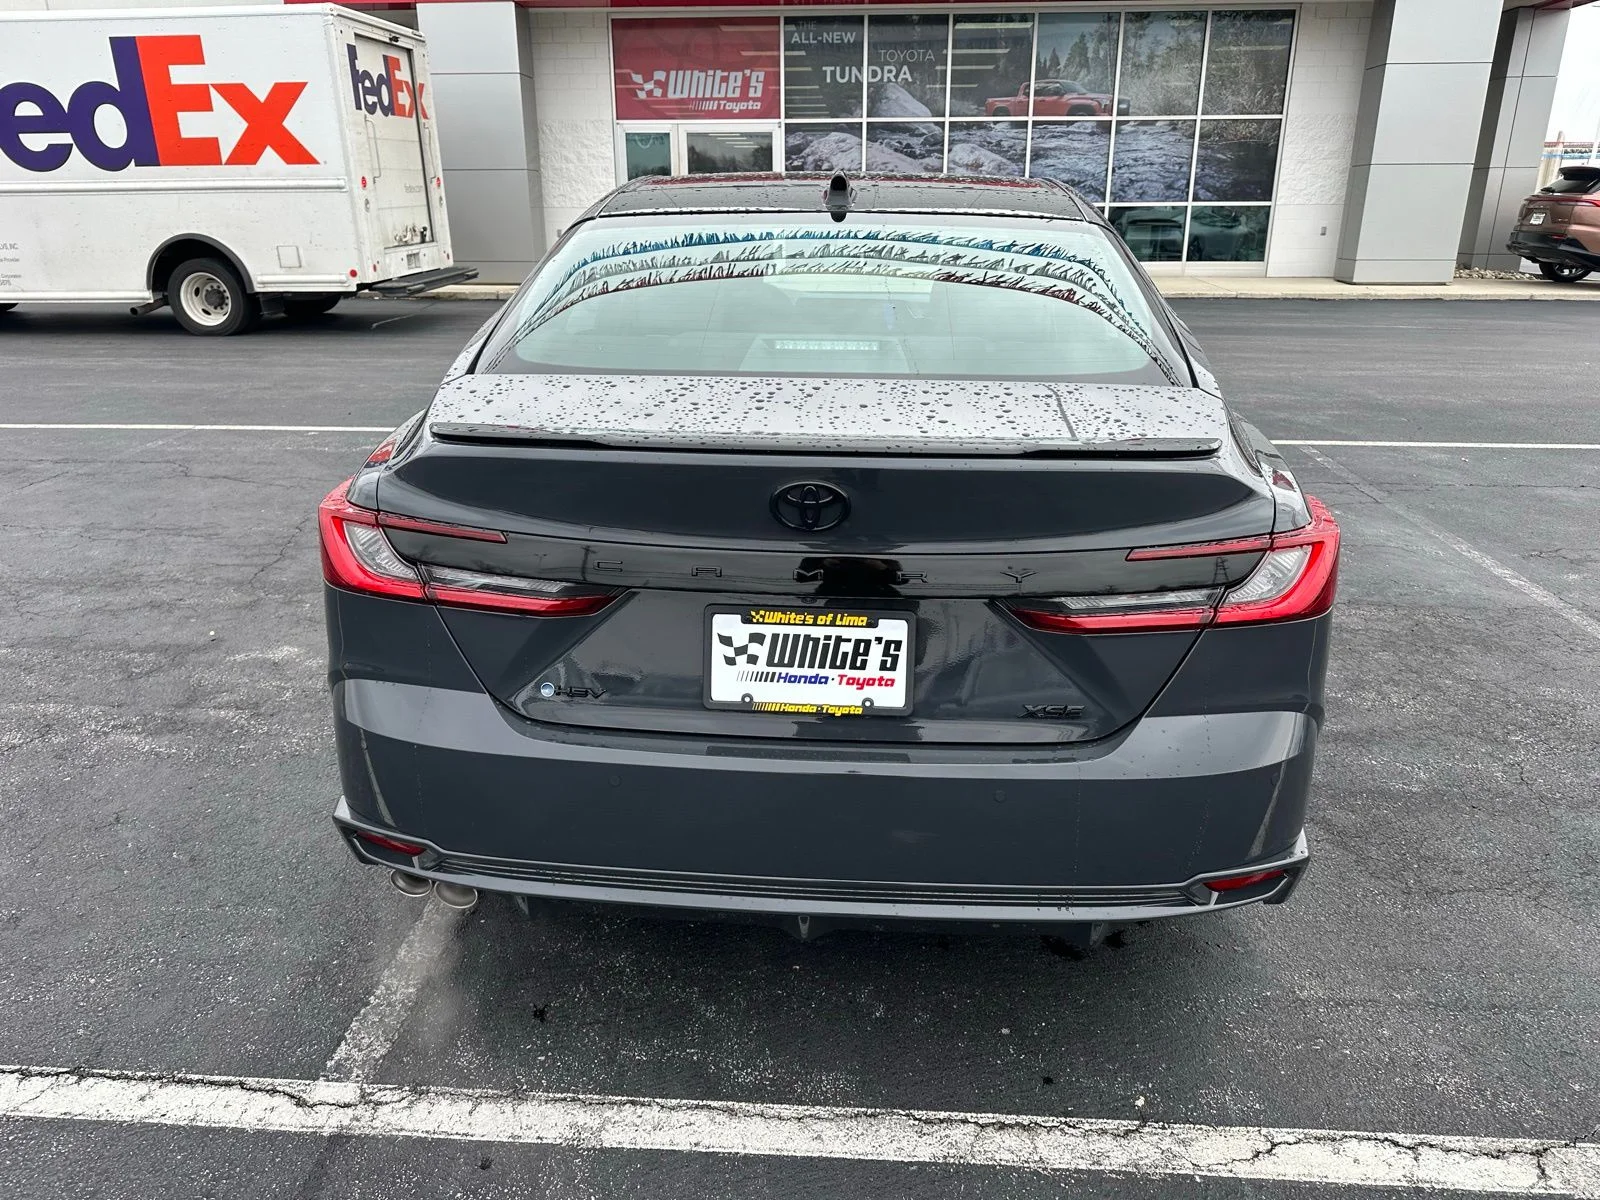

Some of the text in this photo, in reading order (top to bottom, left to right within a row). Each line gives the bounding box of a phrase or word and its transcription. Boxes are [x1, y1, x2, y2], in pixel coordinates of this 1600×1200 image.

[798, 21, 817, 31] THE
[791, 32, 856, 44] ALL-NEW
[878, 49, 936, 62] TOYOTA
[347, 43, 430, 120] FedEx
[822, 65, 913, 83] TUNDRA
[0, 35, 320, 172] edEx
[719, 100, 762, 113] Toyota
[593, 559, 1039, 584] CAMRY
[764, 612, 868, 626] White's of Lima
[776, 672, 896, 690] Honda Toyota
[780, 703, 863, 717] Honda Toyota
[1017, 704, 1085, 720] XSE
